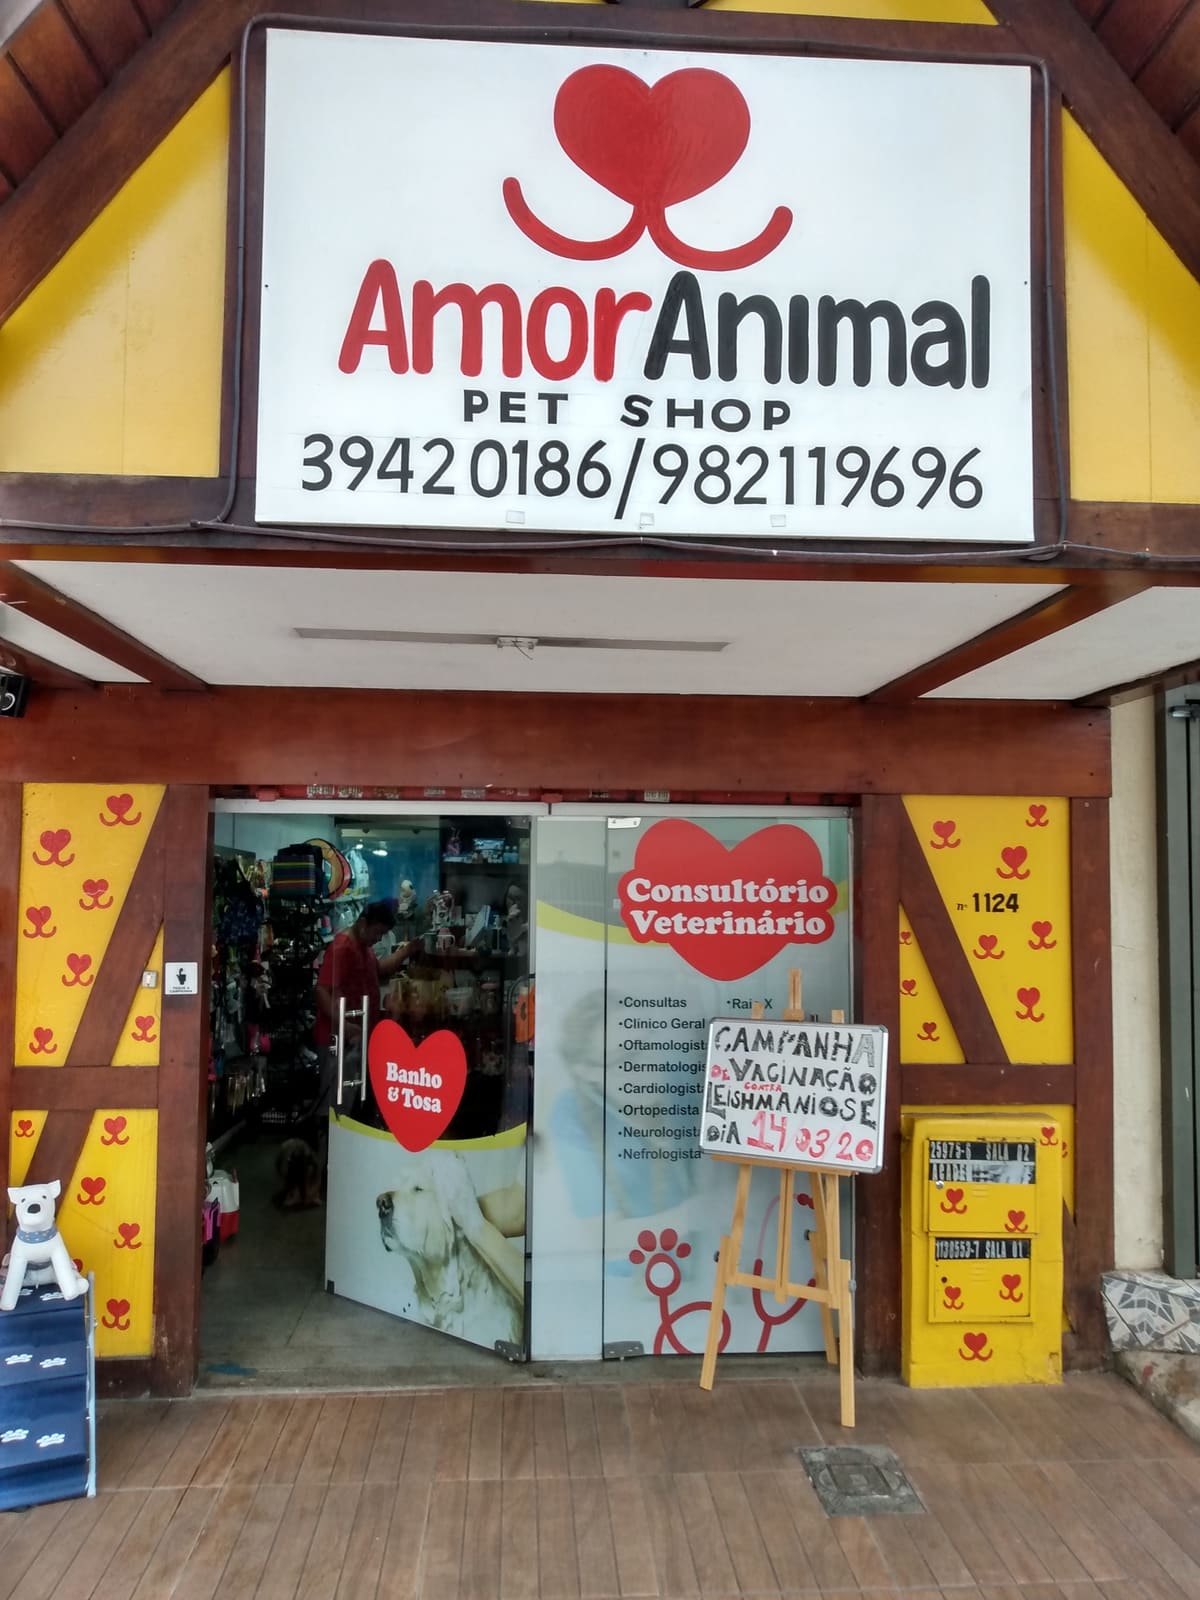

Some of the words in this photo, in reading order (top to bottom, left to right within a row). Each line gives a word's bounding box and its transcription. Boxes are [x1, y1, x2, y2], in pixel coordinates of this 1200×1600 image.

[463, 389, 569, 425] PET
[620, 394, 791, 433] SHOP
[626, 878, 829, 904] Consultório
[972, 892, 1019, 913] 1124
[630, 910, 826, 935] Veterinário
[623, 996, 687, 1009] Consultas
[732, 998, 758, 1009] Rai
[764, 998, 773, 1009] X
[670, 1018, 706, 1030] Geral
[714, 1026, 875, 1068] CAMPANHA
[386, 1062, 442, 1089] Banho
[744, 1082, 782, 1092] CONTRA
[402, 1087, 442, 1114] Tosa
[623, 1104, 700, 1118] Ortopedista
[623, 1148, 702, 1162] Nefrologista
[985, 1143, 1009, 1161] SALA
[984, 1240, 1007, 1259] SALA
